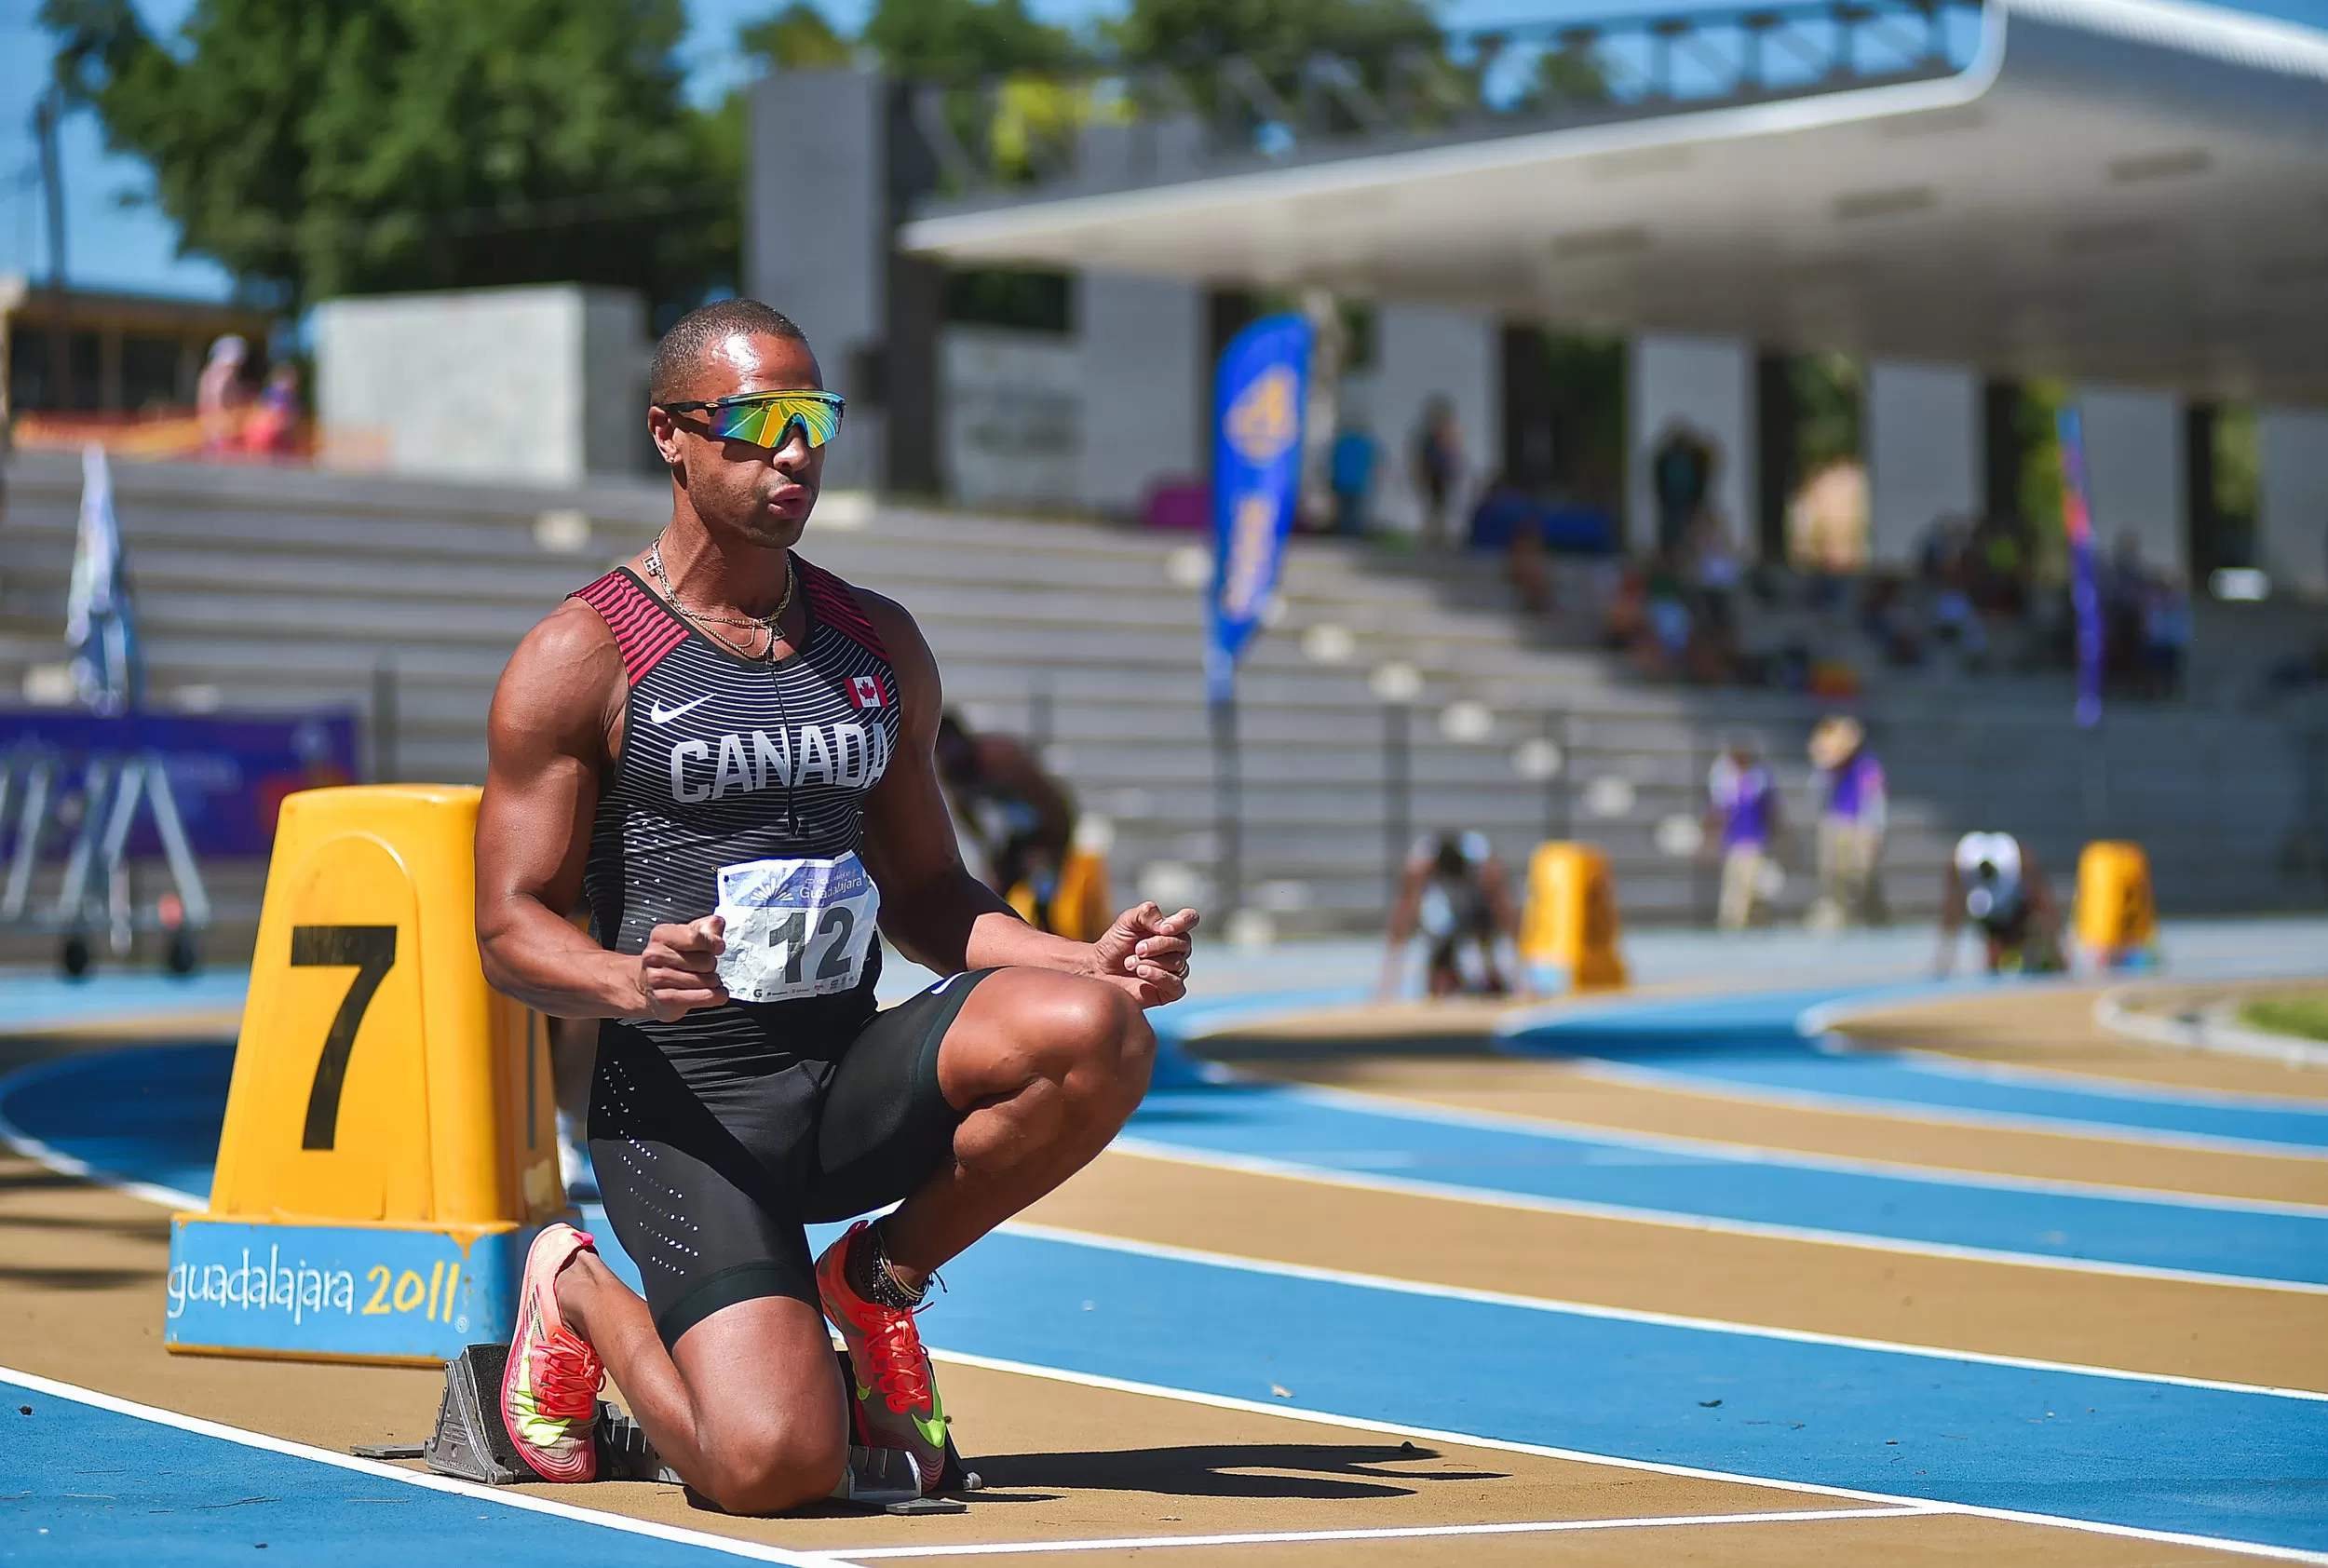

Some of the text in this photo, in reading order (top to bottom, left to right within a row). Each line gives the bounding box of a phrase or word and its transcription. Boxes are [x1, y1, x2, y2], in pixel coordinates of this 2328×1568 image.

[670, 723, 887, 804] CANADA
[768, 907, 855, 984] 12
[291, 925, 399, 1152] 7
[167, 1243, 461, 1327] guadalajara 2011
